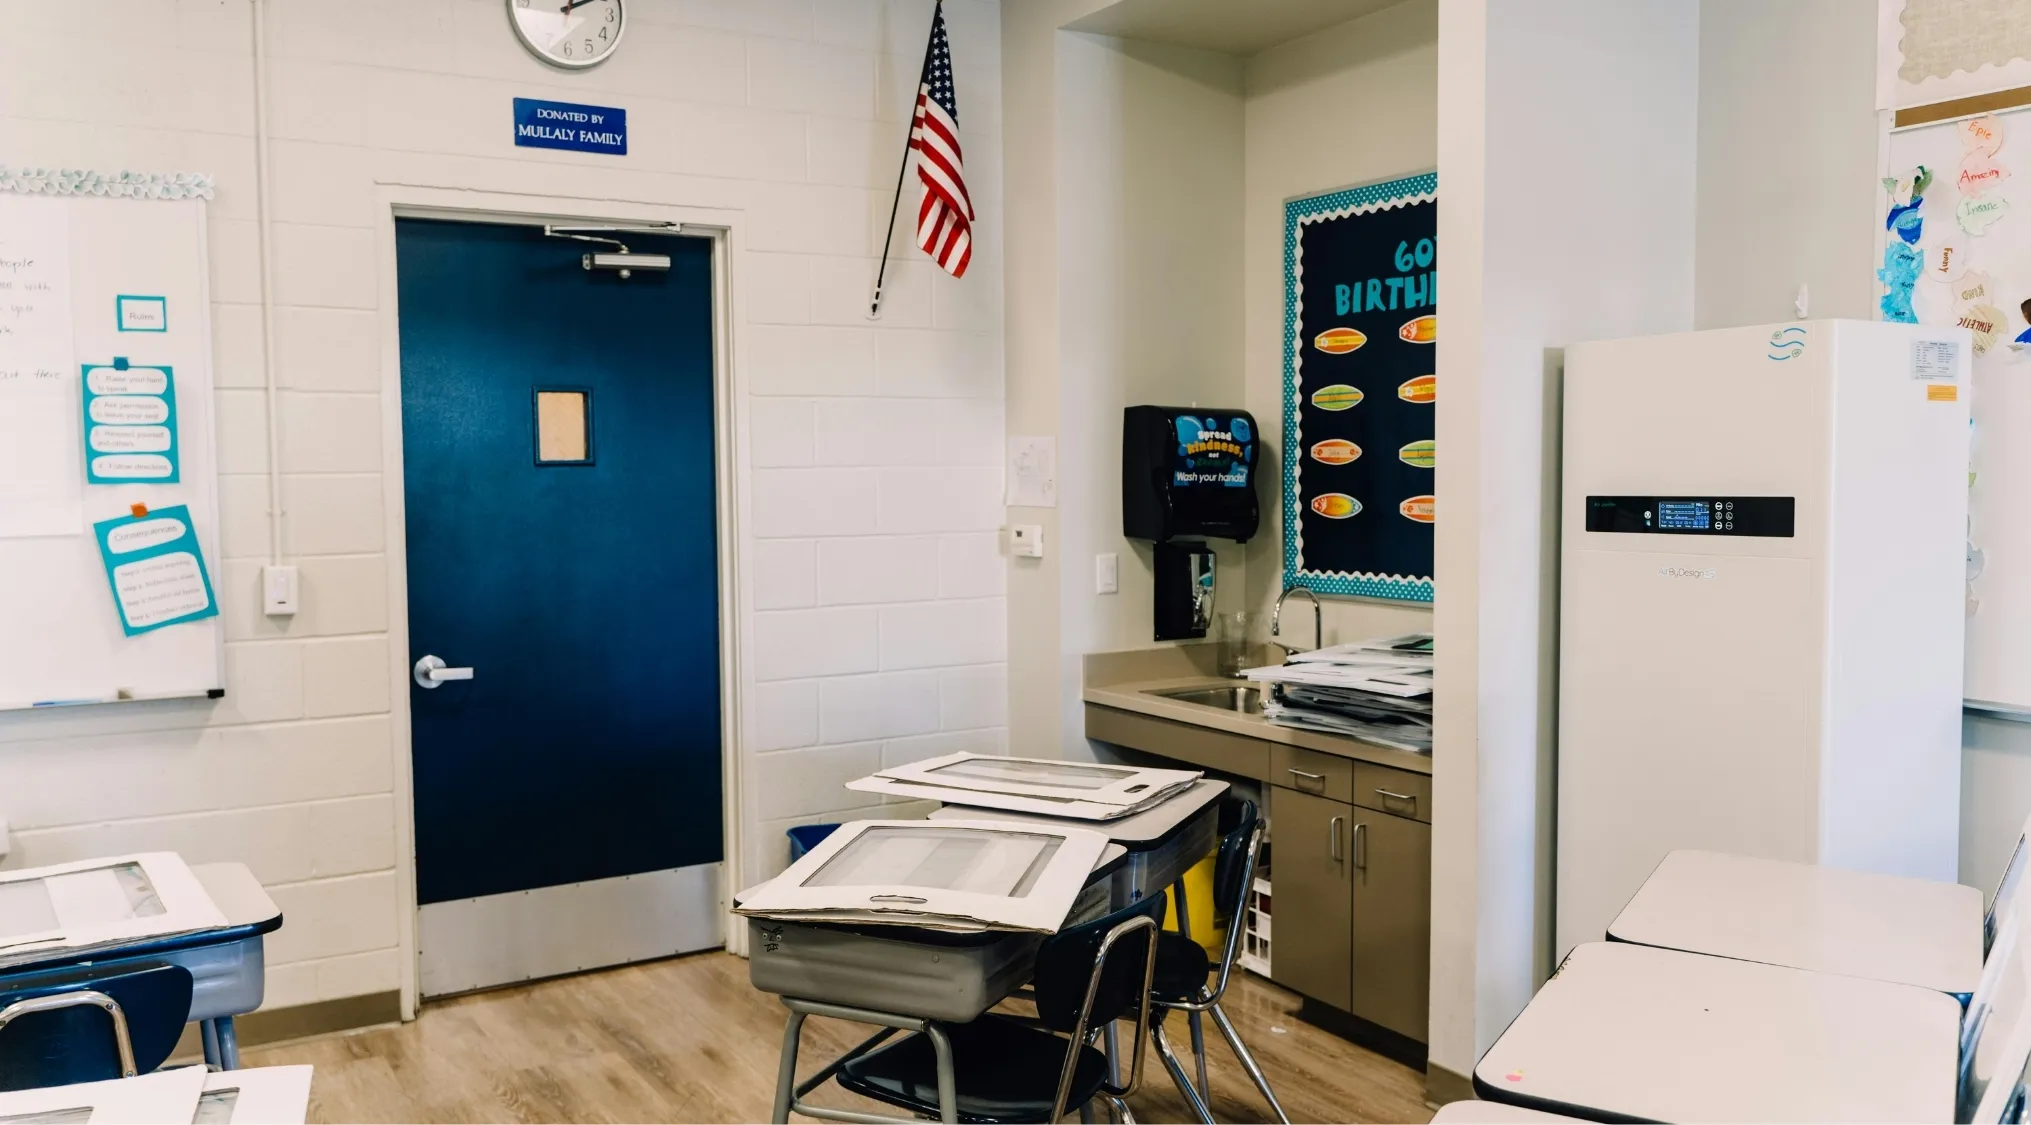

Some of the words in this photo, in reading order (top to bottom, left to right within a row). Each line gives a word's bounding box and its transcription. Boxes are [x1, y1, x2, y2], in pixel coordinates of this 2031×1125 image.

[604, 8, 614, 23] 3
[598, 26, 608, 42] 4
[564, 41, 572, 57] 6
[584, 38, 594, 54] 5
[536, 108, 588, 123] DONATED
[591, 114, 604, 124] BY
[518, 124, 576, 141] MULLALY
[580, 130, 623, 146] FAMILY
[1960, 169, 2000, 183] Amazing
[1965, 202, 1998, 216] Insane
[1961, 284, 1985, 300] KIND
[1957, 318, 1994, 334] ATHLETIC
[1176, 472, 1198, 482] Wash
[1199, 474, 1218, 484] your
[1218, 472, 1246, 482] hands!
